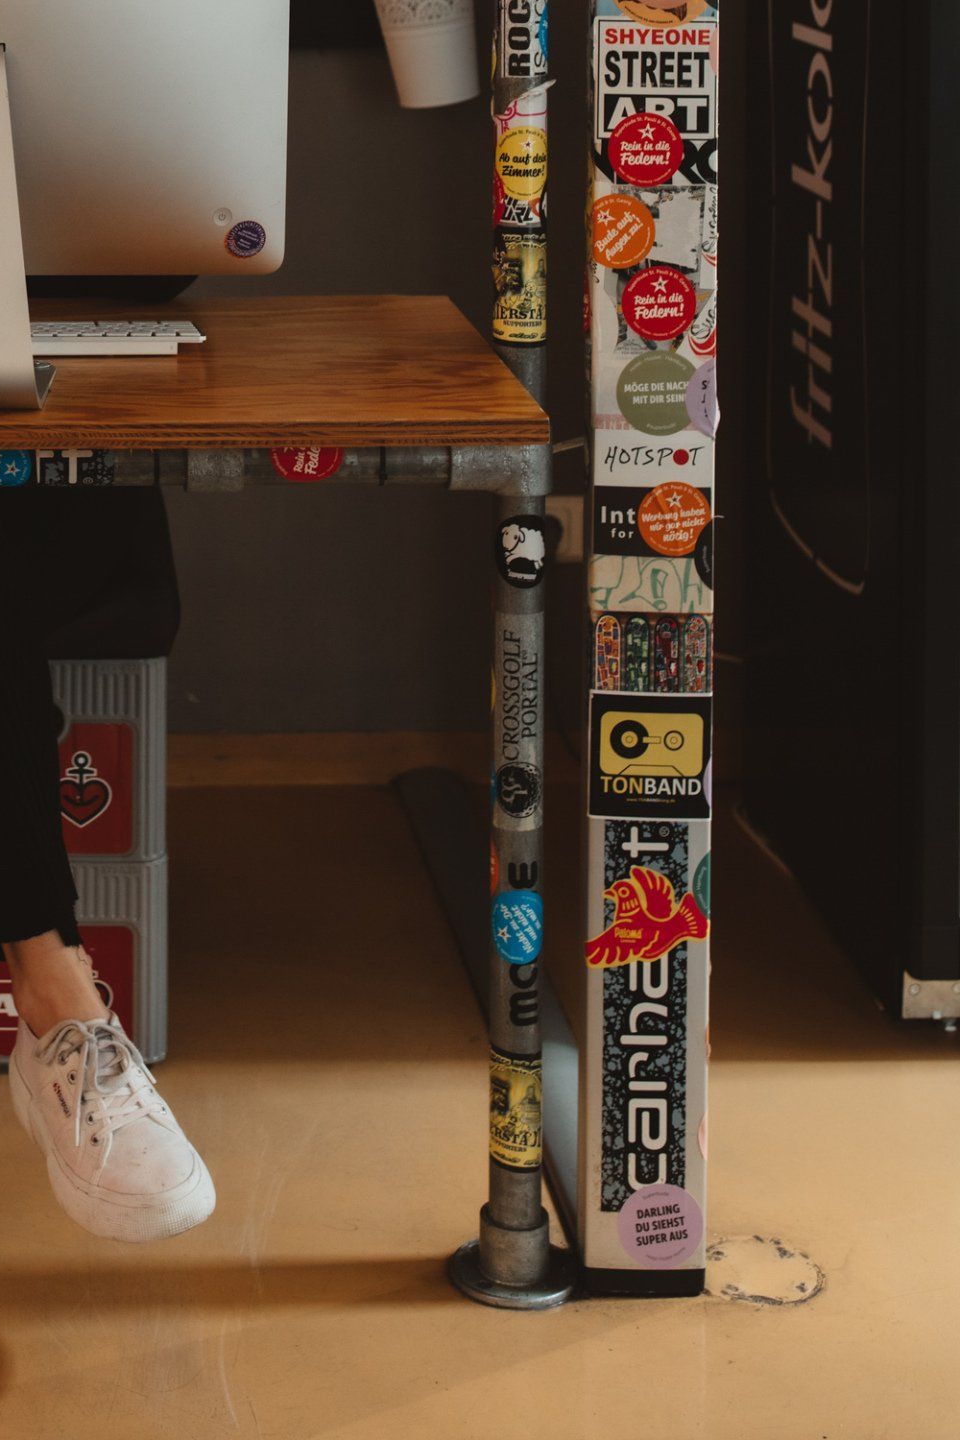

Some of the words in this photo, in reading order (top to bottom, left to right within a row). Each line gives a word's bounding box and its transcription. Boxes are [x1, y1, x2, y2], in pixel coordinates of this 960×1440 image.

[604, 28, 711, 46] SHYEONE
[604, 50, 709, 88] STREET
[607, 96, 708, 132] ART
[620, 141, 641, 152] Rein
[643, 141, 653, 151] in
[655, 140, 670, 151] die
[499, 152, 511, 163] Ab
[512, 154, 530, 166] auf
[620, 150, 670, 166] Federn!
[501, 164, 546, 178] Zimmer!
[594, 227, 619, 252] Bude
[605, 234, 631, 261] Augen
[634, 295, 655, 305] Rein
[657, 295, 666, 304] in
[668, 294, 684, 304] die
[634, 303, 684, 320] Federn!
[624, 381, 649, 392] MÖGE
[651, 382, 664, 392] DIE
[666, 381, 689, 392] NACH
[632, 395, 648, 405] MIT
[650, 394, 664, 404] DIR
[601, 505, 636, 525] Int
[641, 512, 678, 523] Werbung
[680, 508, 706, 520] haben
[611, 528, 634, 539] for
[649, 522, 664, 532] wir
[665, 521, 681, 533] gar
[682, 517, 705, 529] nicht
[662, 529, 694, 543] nötig!
[503, 629, 522, 760] CROSSGOLF
[521, 652, 538, 738] PORTAL
[600, 776, 702, 796] TONBAND
[636, 1203, 681, 1220] DARLING
[635, 1221, 651, 1234] DU
[652, 1216, 686, 1231] SIEHST
[636, 1232, 669, 1247] SUPER
[669, 1228, 689, 1243] AUS
